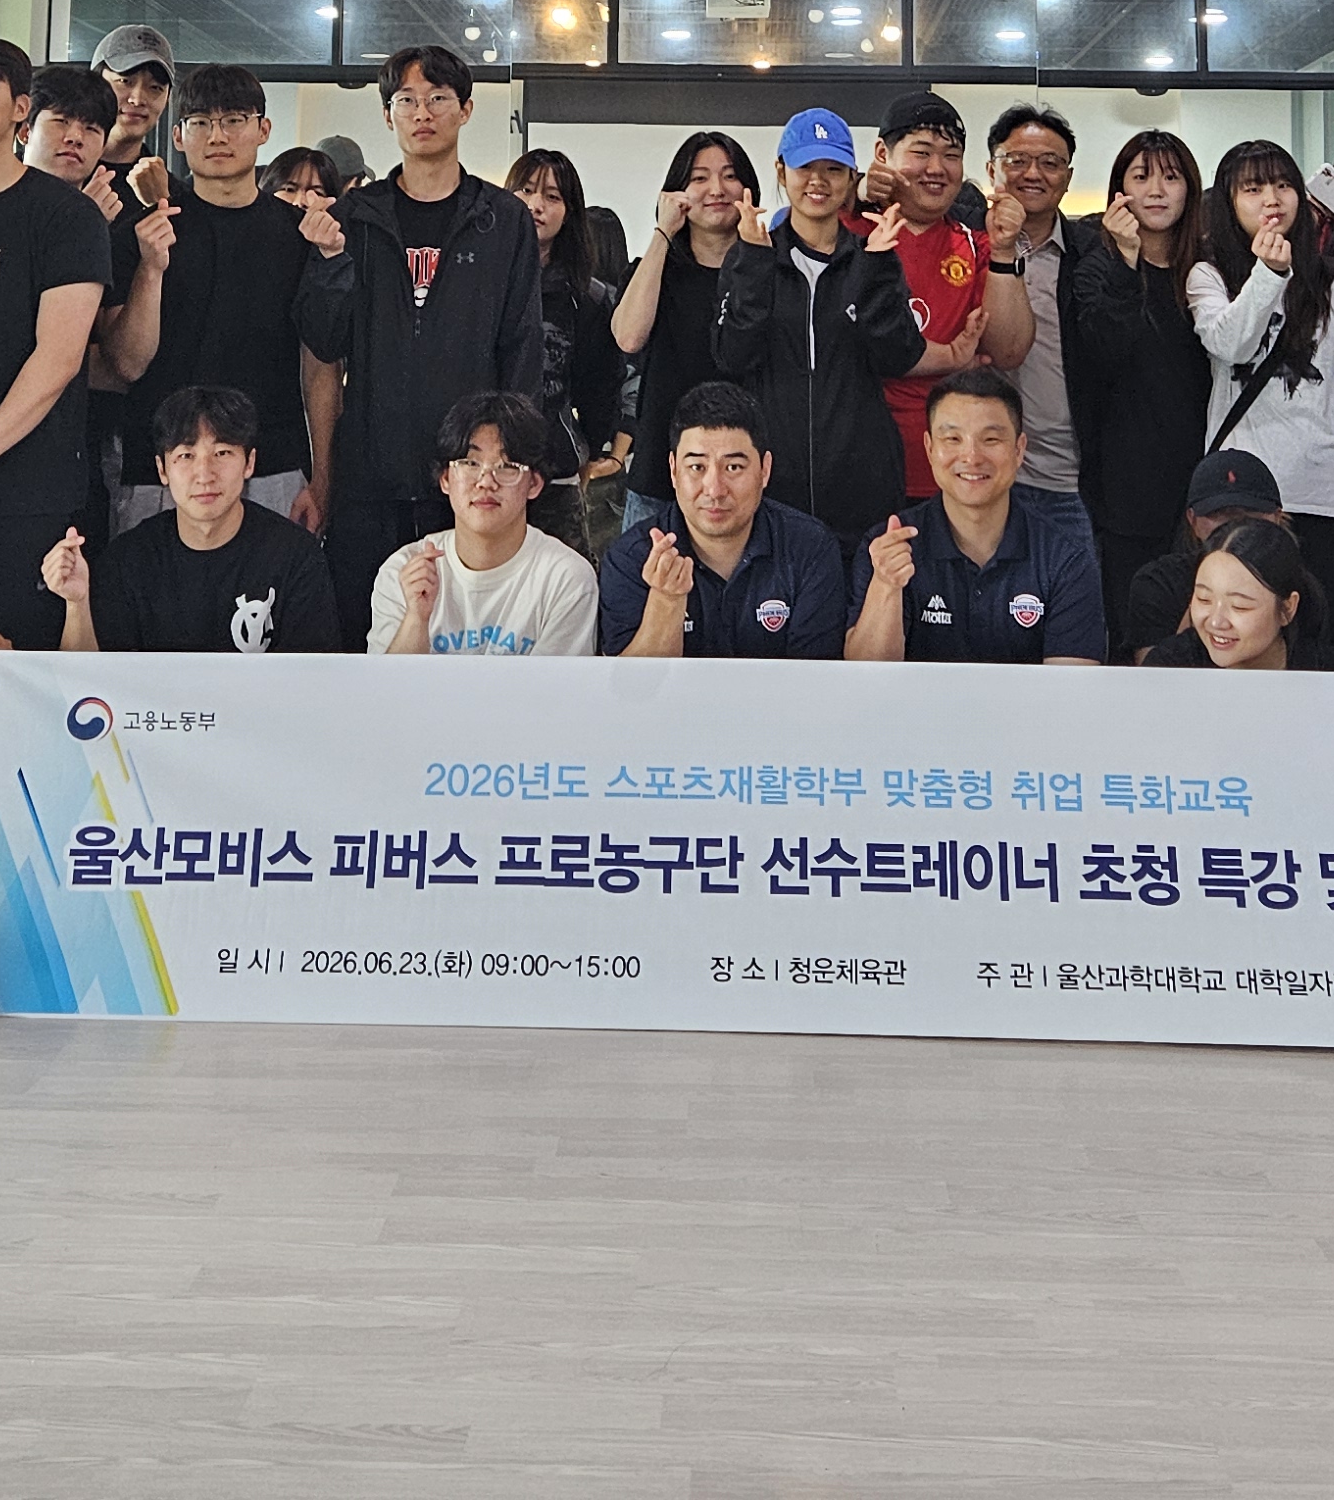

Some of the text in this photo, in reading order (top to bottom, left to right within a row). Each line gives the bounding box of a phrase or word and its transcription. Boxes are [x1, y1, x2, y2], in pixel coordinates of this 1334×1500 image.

[123, 710, 217, 732] 고용노동부
[424, 762, 1253, 817] 2026년도 스포츠재활학부 맞춤형 취업 특화교육
[69, 825, 314, 888] 울산모비스
[329, 830, 479, 890] 피버스
[494, 832, 745, 894] 프로농구단
[760, 836, 1060, 903] 선수트레이너
[1079, 843, 1181, 907] 초청
[1197, 847, 1303, 911] 특강
[480, 953, 642, 980] 09:00~15:00
[788, 956, 908, 987] 청운체육관
[1055, 962, 1227, 994] 울산과학대학교
